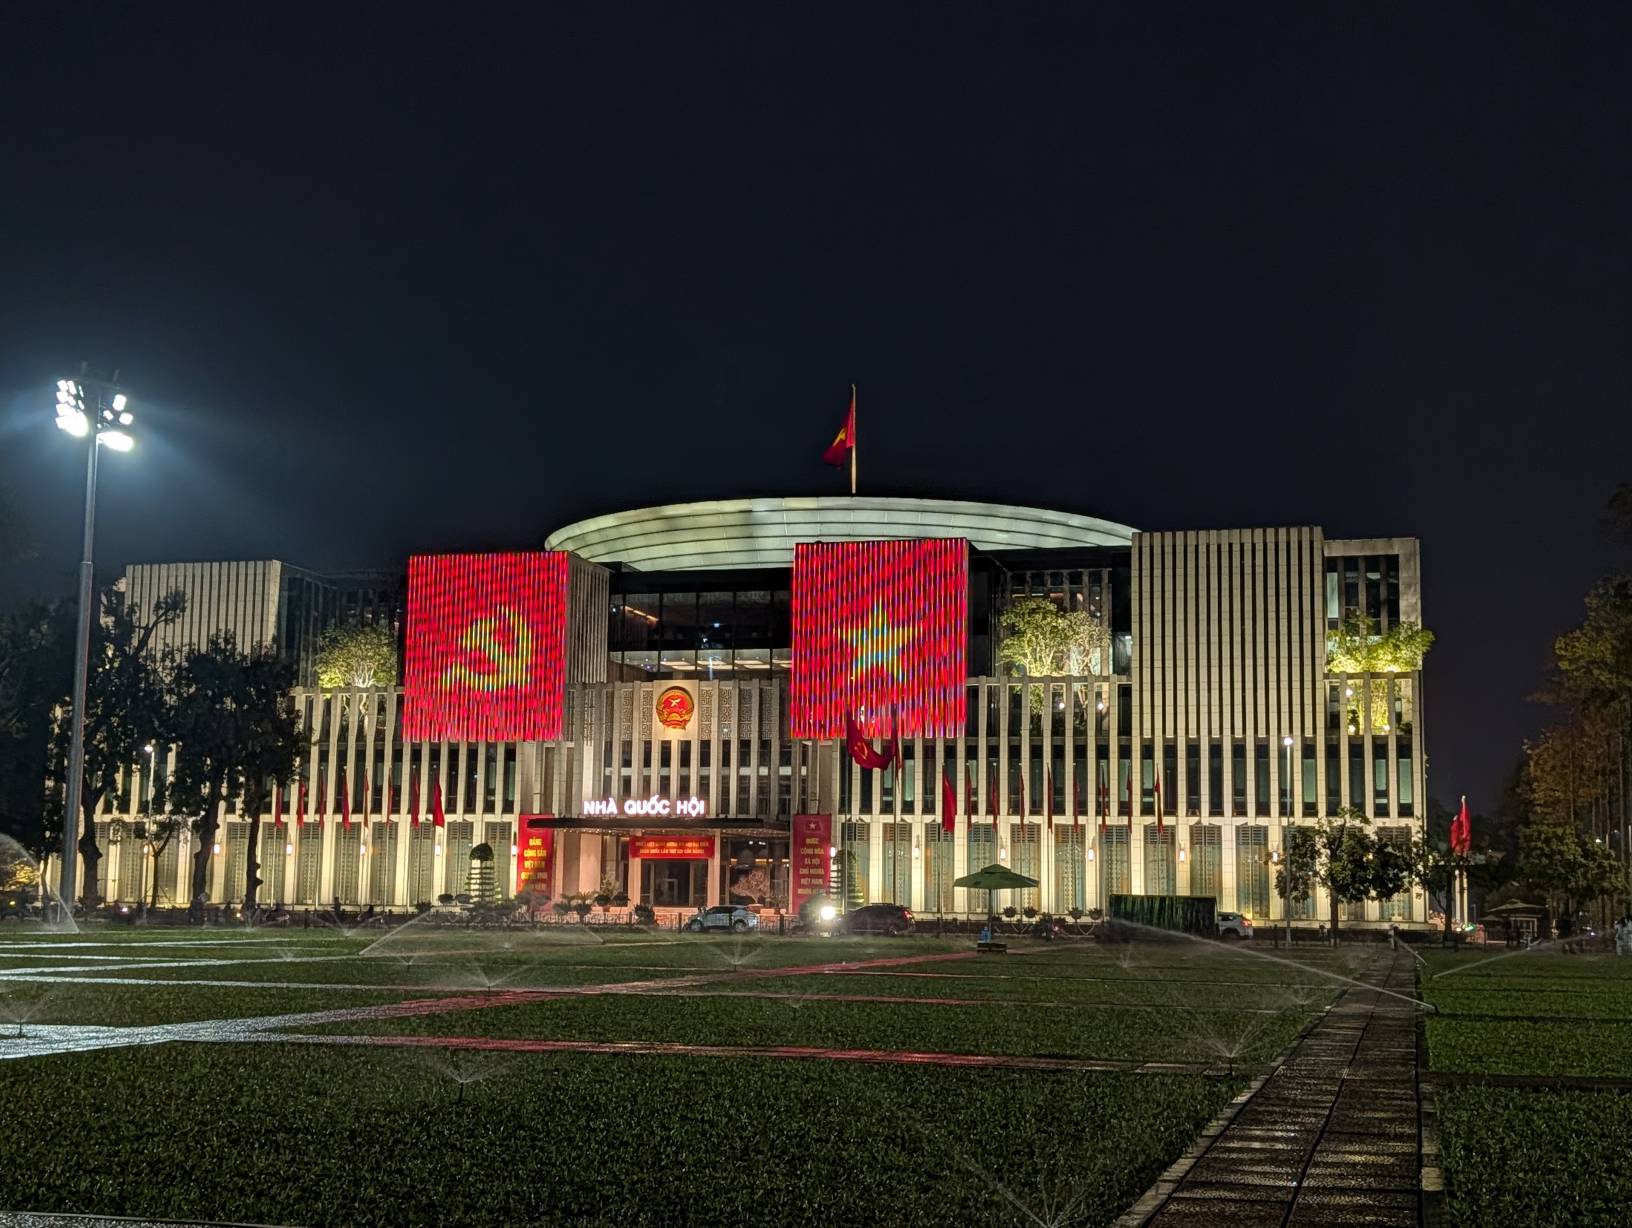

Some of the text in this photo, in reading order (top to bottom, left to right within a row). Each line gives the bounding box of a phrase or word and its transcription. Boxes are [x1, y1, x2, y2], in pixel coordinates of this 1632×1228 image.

[583, 795, 705, 817] NHÀ QUỐC HỘI
